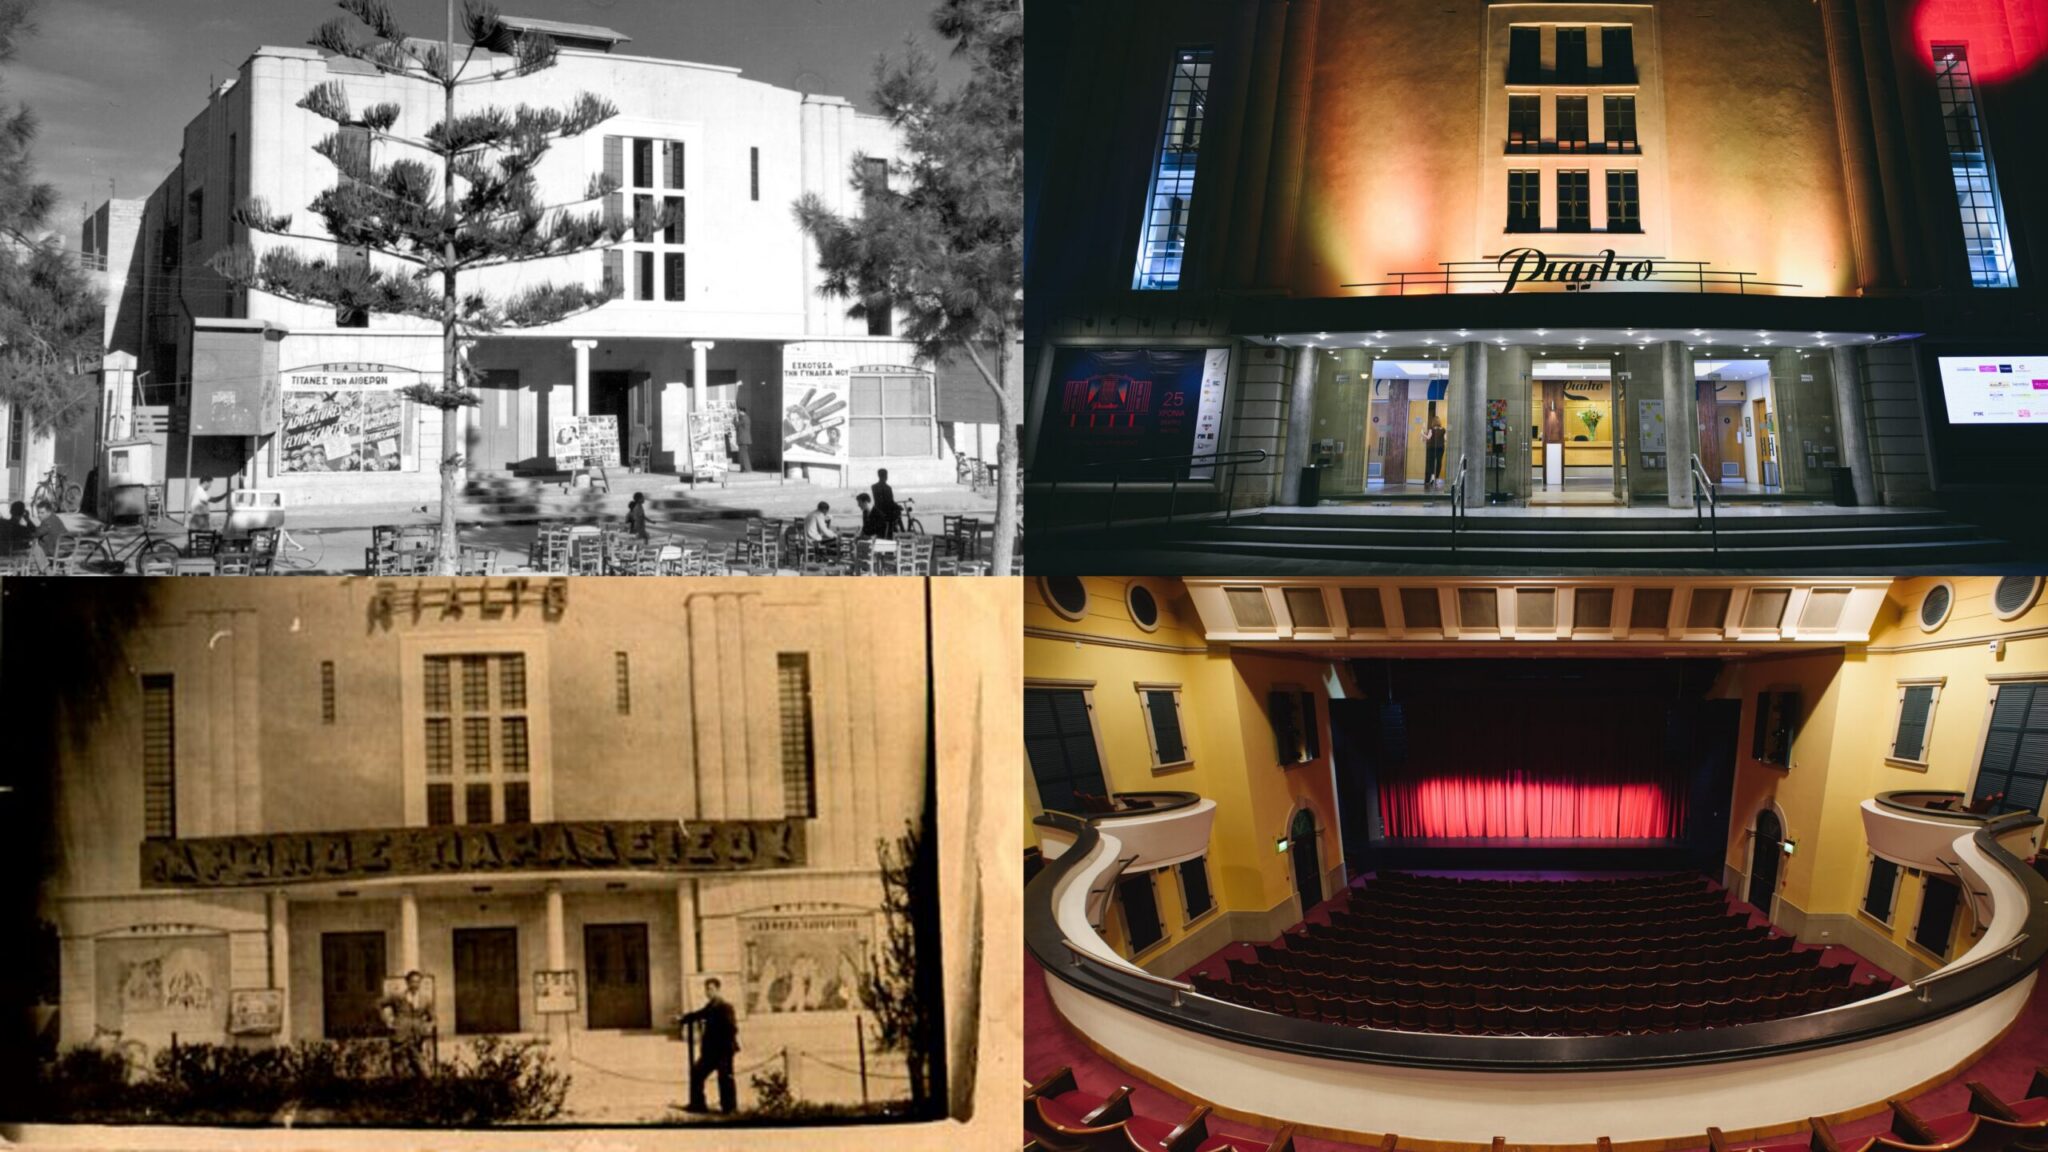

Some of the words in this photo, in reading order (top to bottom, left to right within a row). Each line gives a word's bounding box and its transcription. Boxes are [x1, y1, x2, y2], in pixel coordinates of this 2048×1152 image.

[323, 363, 384, 373] RIALTO
[791, 361, 833, 369] ΕΣΚΟΤΩΣΑ
[859, 365, 906, 374] RIALTO
[784, 369, 798, 377] ΤΗΝ
[800, 369, 833, 377] ΓΥΝΑΙΚΑ
[291, 375, 328, 385] ΤΙΤΑΝΕΣ
[348, 375, 388, 385] ΑΙΘΕΡΩΝ
[1163, 392, 1184, 407] 25
